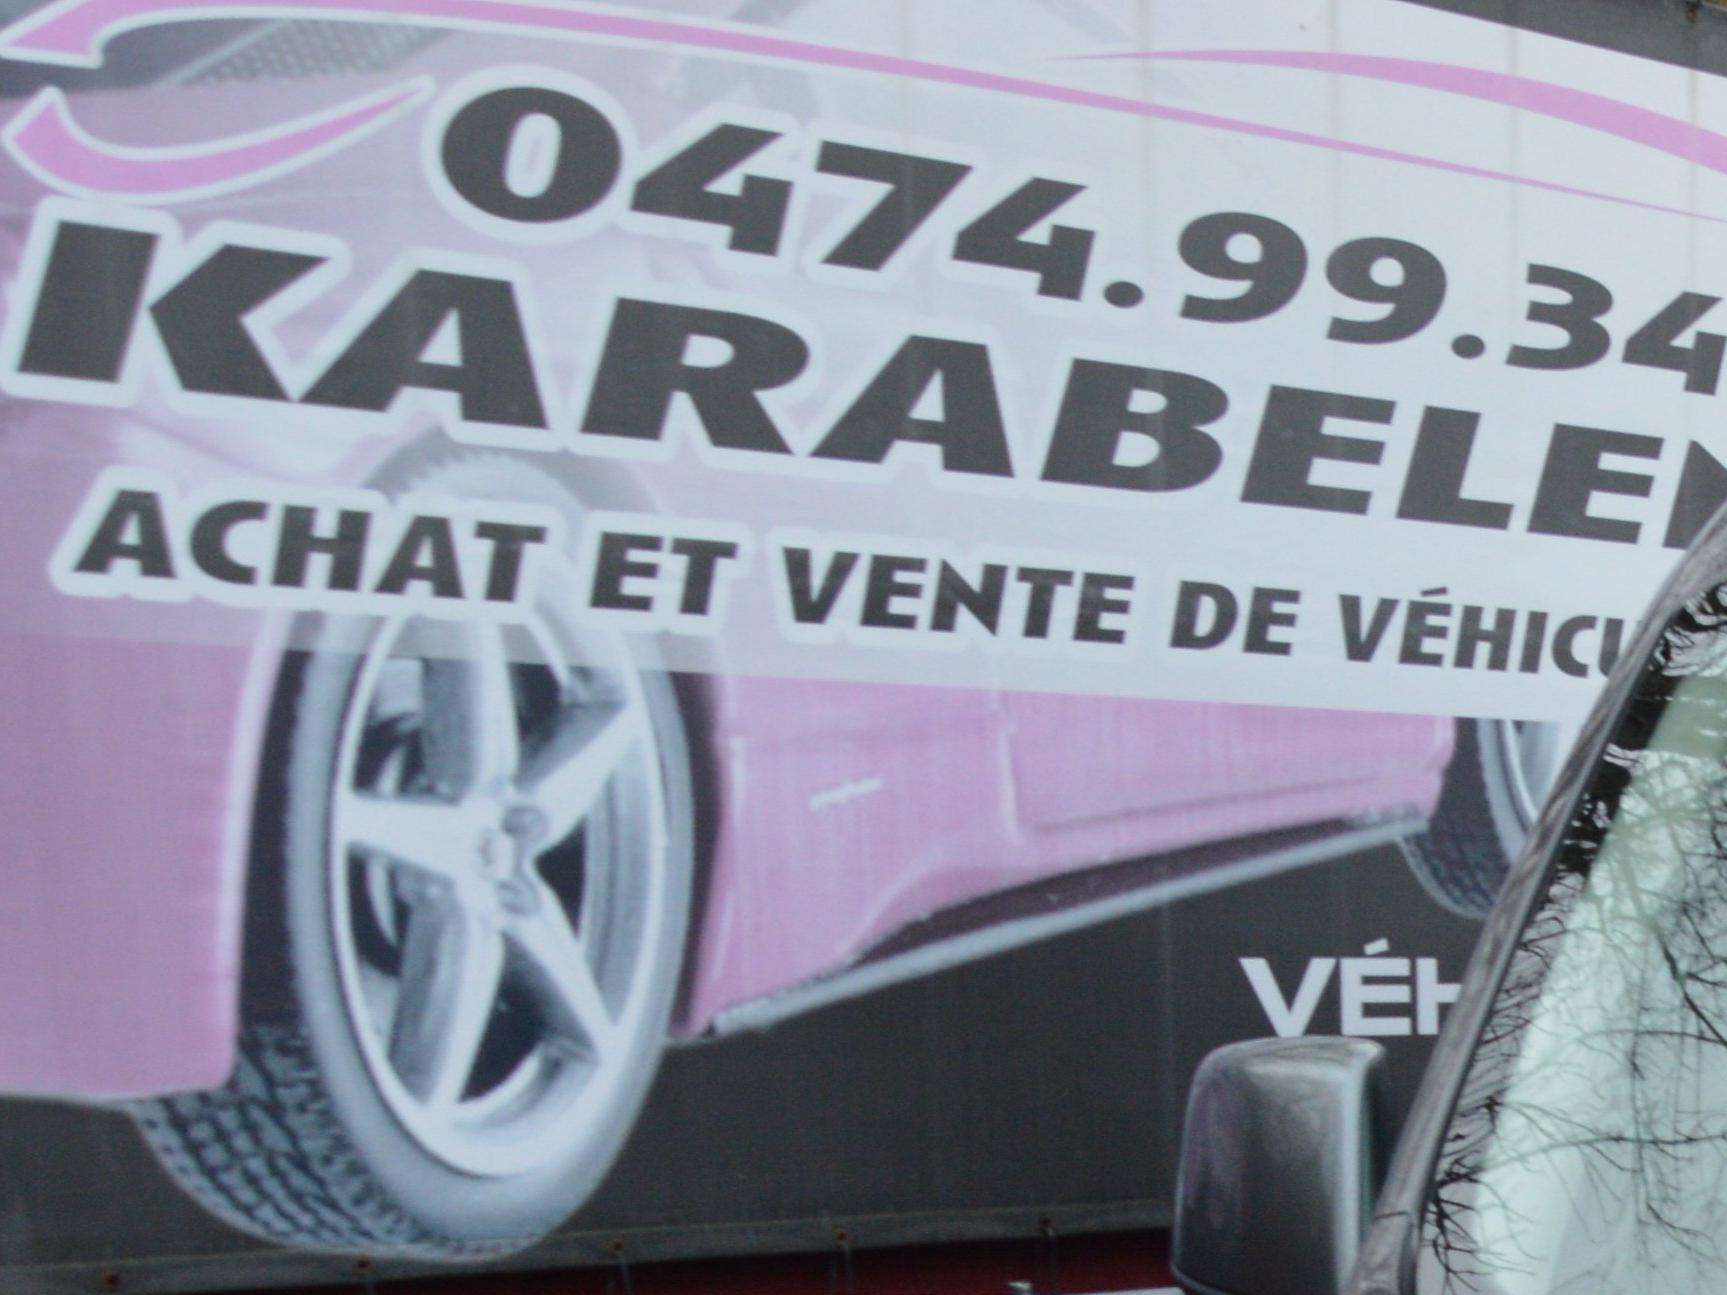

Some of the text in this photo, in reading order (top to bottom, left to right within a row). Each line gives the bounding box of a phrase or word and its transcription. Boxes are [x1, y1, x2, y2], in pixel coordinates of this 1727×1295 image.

[75, 490, 546, 602] ACHAT
[590, 532, 738, 616] ET
[784, 548, 1135, 645] VENTE
[1170, 581, 1299, 656] DE
